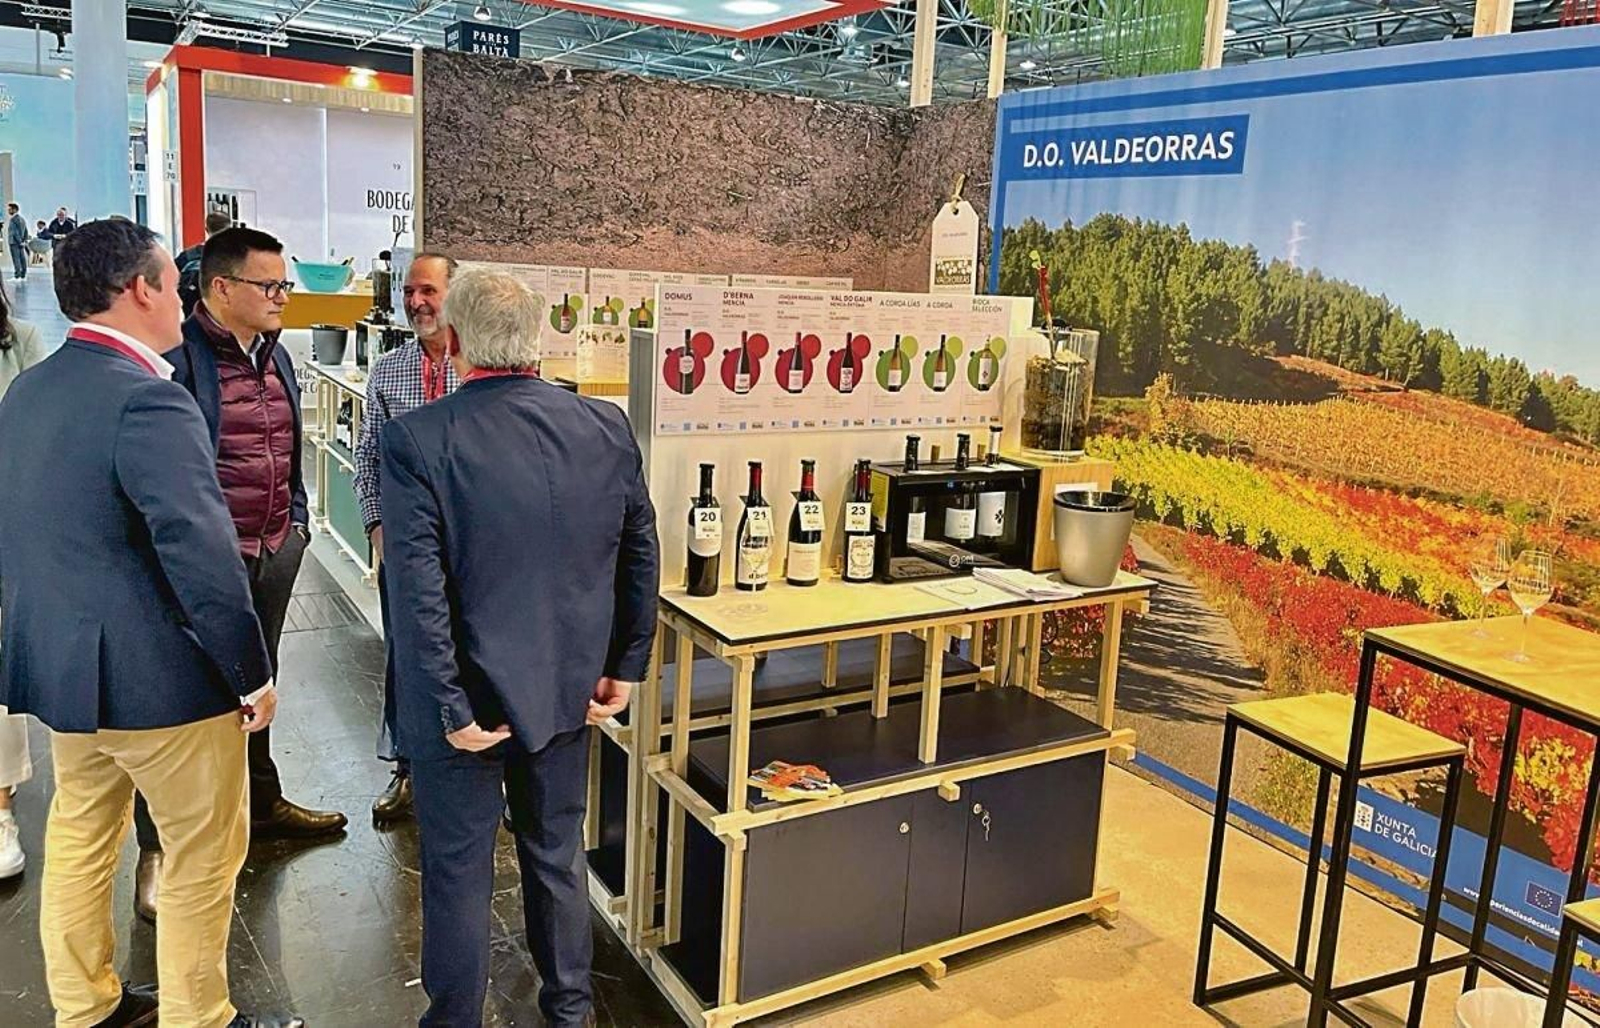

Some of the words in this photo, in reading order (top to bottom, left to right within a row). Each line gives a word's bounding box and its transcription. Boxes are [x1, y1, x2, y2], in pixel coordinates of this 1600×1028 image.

[1023, 143, 1064, 168] D.O.
[1071, 131, 1234, 166] VALDEORRAS
[367, 189, 415, 211] BODEG
[392, 214, 410, 234] DE
[664, 292, 693, 300] DOMUS
[723, 291, 754, 300] D'BERNA
[854, 295, 873, 303] GALIR
[804, 504, 819, 514] 22
[851, 505, 866, 516] 23
[700, 511, 717, 522] 20
[752, 510, 767, 520] 21
[1374, 824, 1390, 838] DE
[1375, 812, 1418, 840] XUNTA
